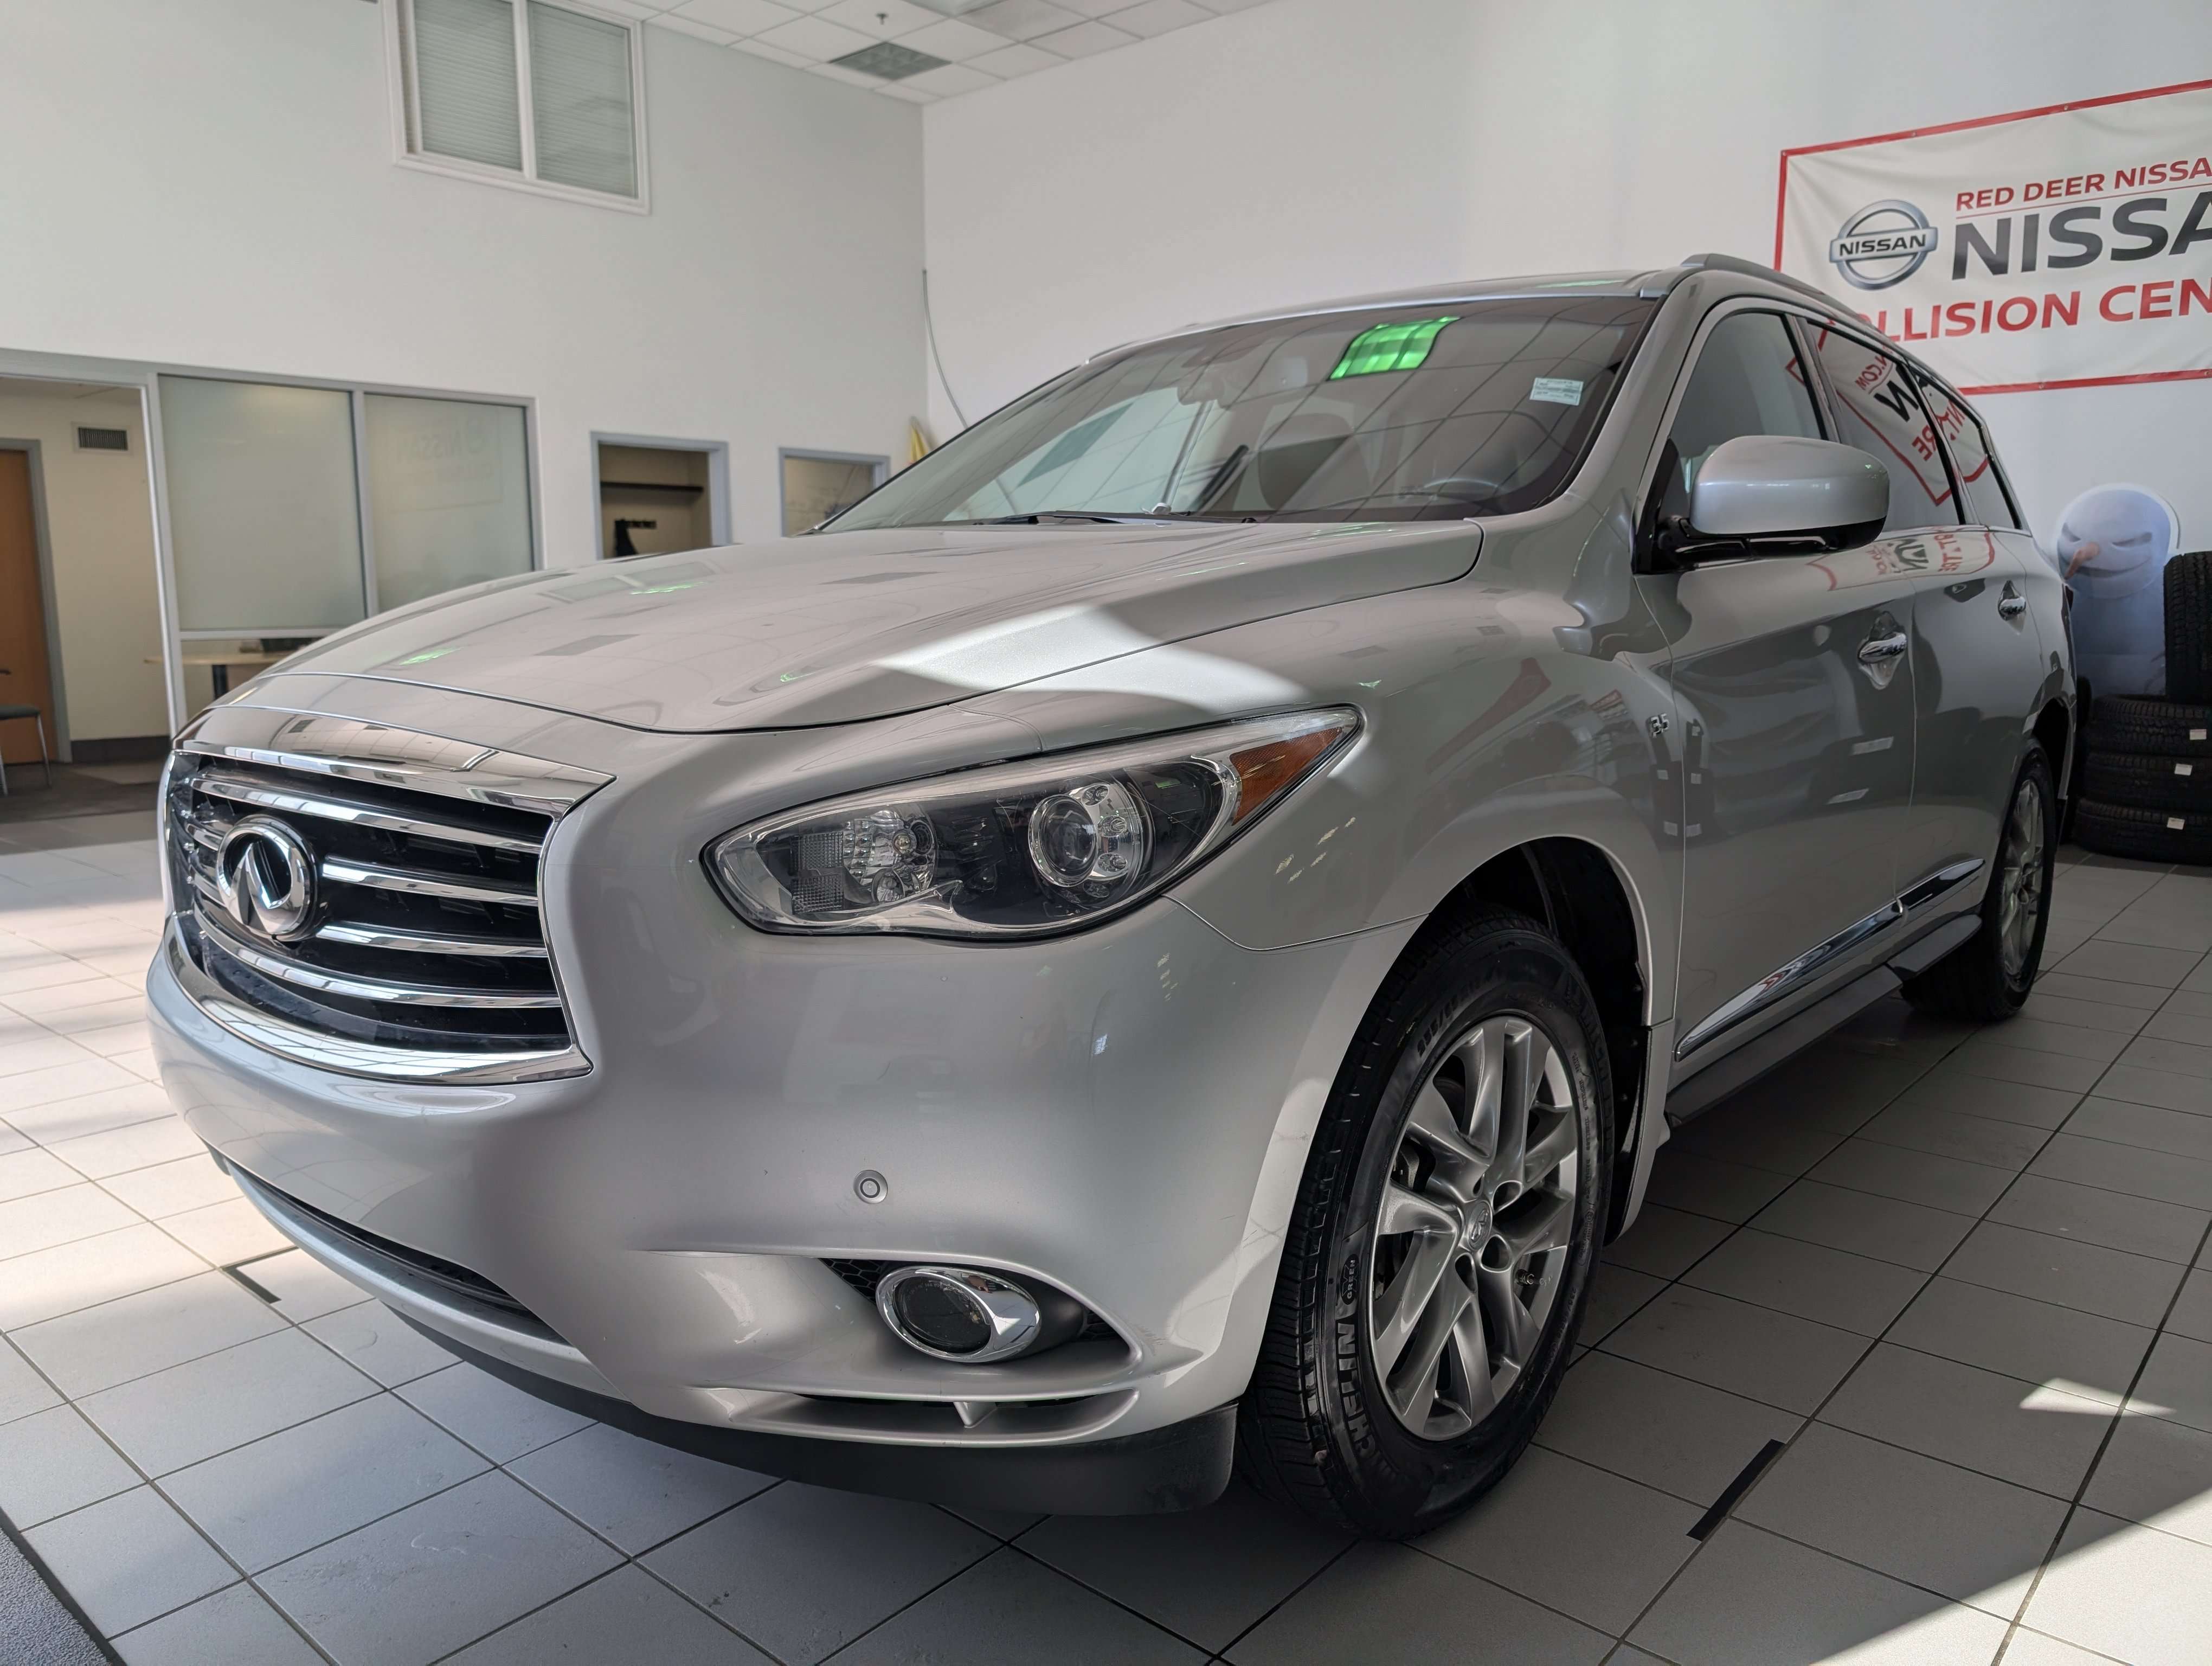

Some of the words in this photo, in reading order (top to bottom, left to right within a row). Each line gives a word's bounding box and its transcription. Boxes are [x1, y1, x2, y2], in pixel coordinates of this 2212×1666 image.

[1956, 187, 2015, 212] RED
[2023, 174, 2105, 202] DEER
[2114, 157, 2212, 189] NISSA
[1840, 234, 1926, 257] NISSAN
[1857, 291, 2081, 342] LLISION
[2099, 278, 2212, 322] CEN
[1346, 1259, 1356, 1299] GREEN
